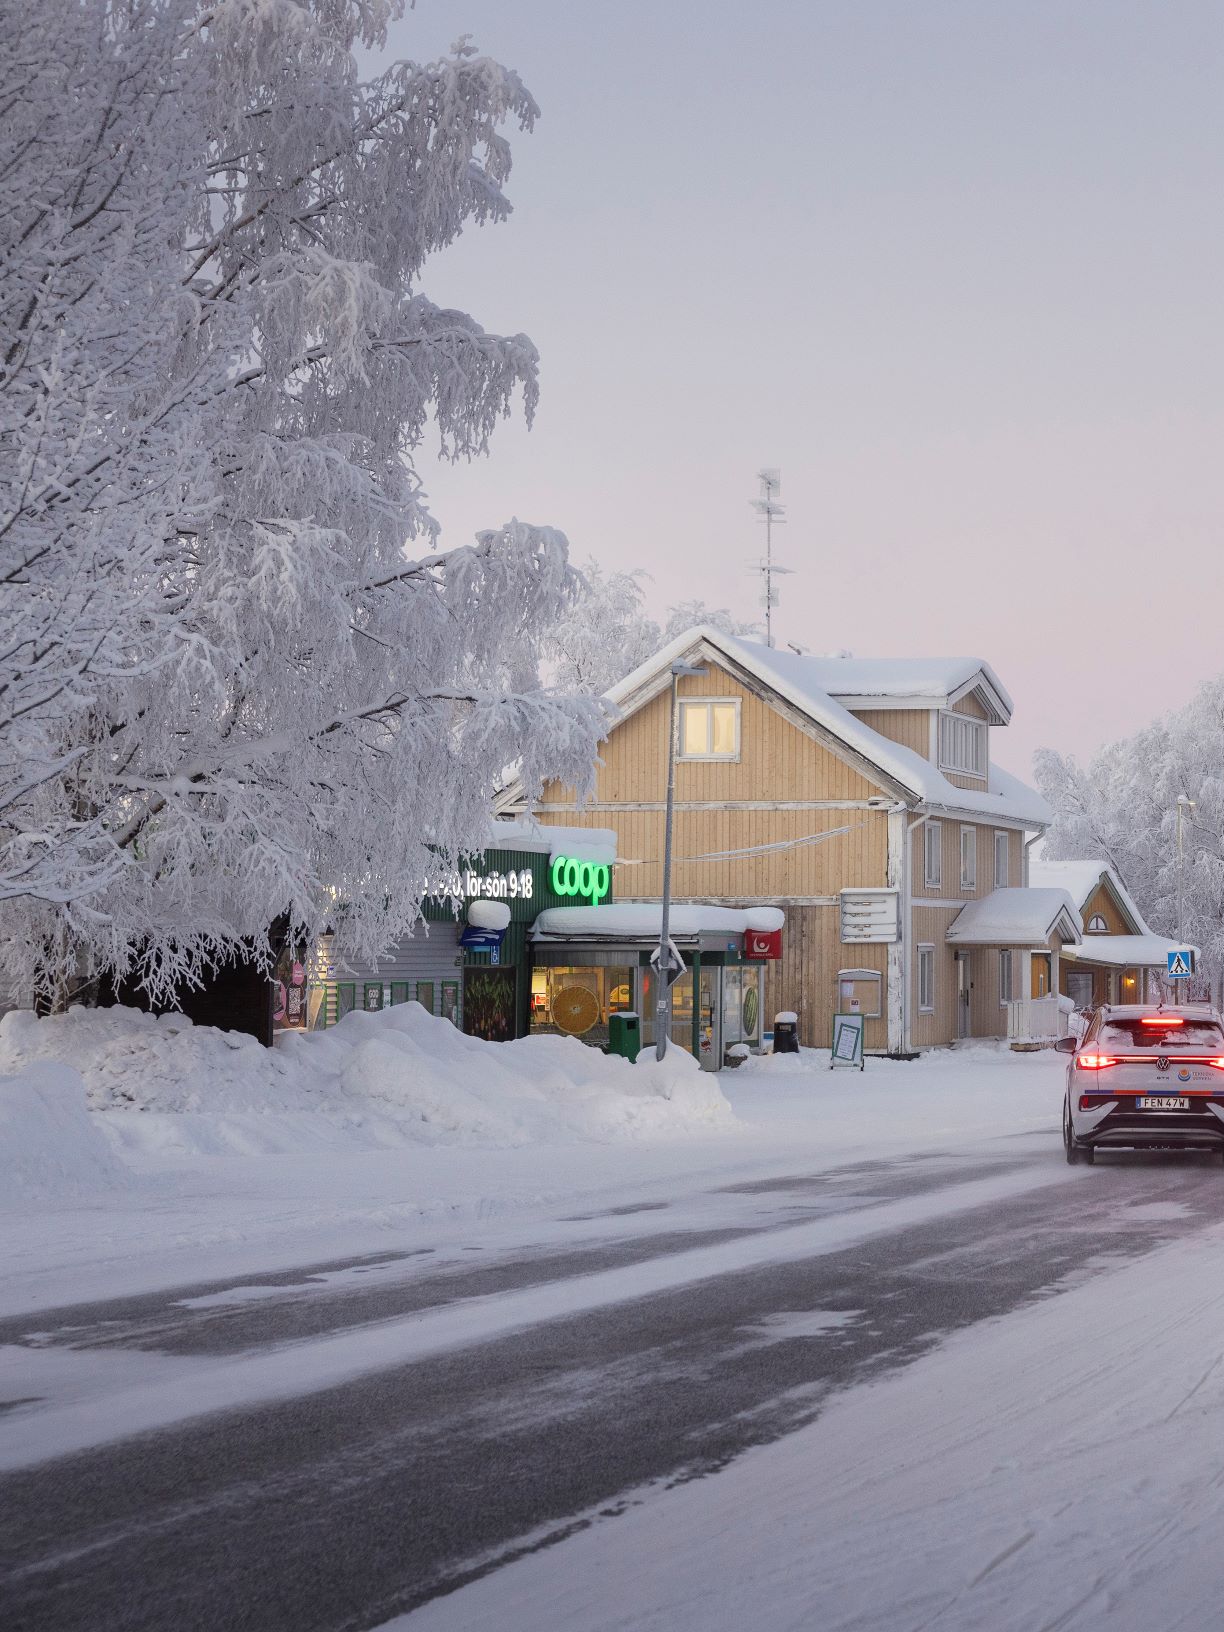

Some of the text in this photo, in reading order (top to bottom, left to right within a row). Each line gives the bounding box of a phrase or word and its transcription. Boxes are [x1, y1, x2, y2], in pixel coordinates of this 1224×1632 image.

[466, 869, 507, 898] lör-sön
[509, 872, 533, 898] 9-18
[552, 856, 609, 907] coop
[1144, 1098, 1185, 1107] FEN 47W
